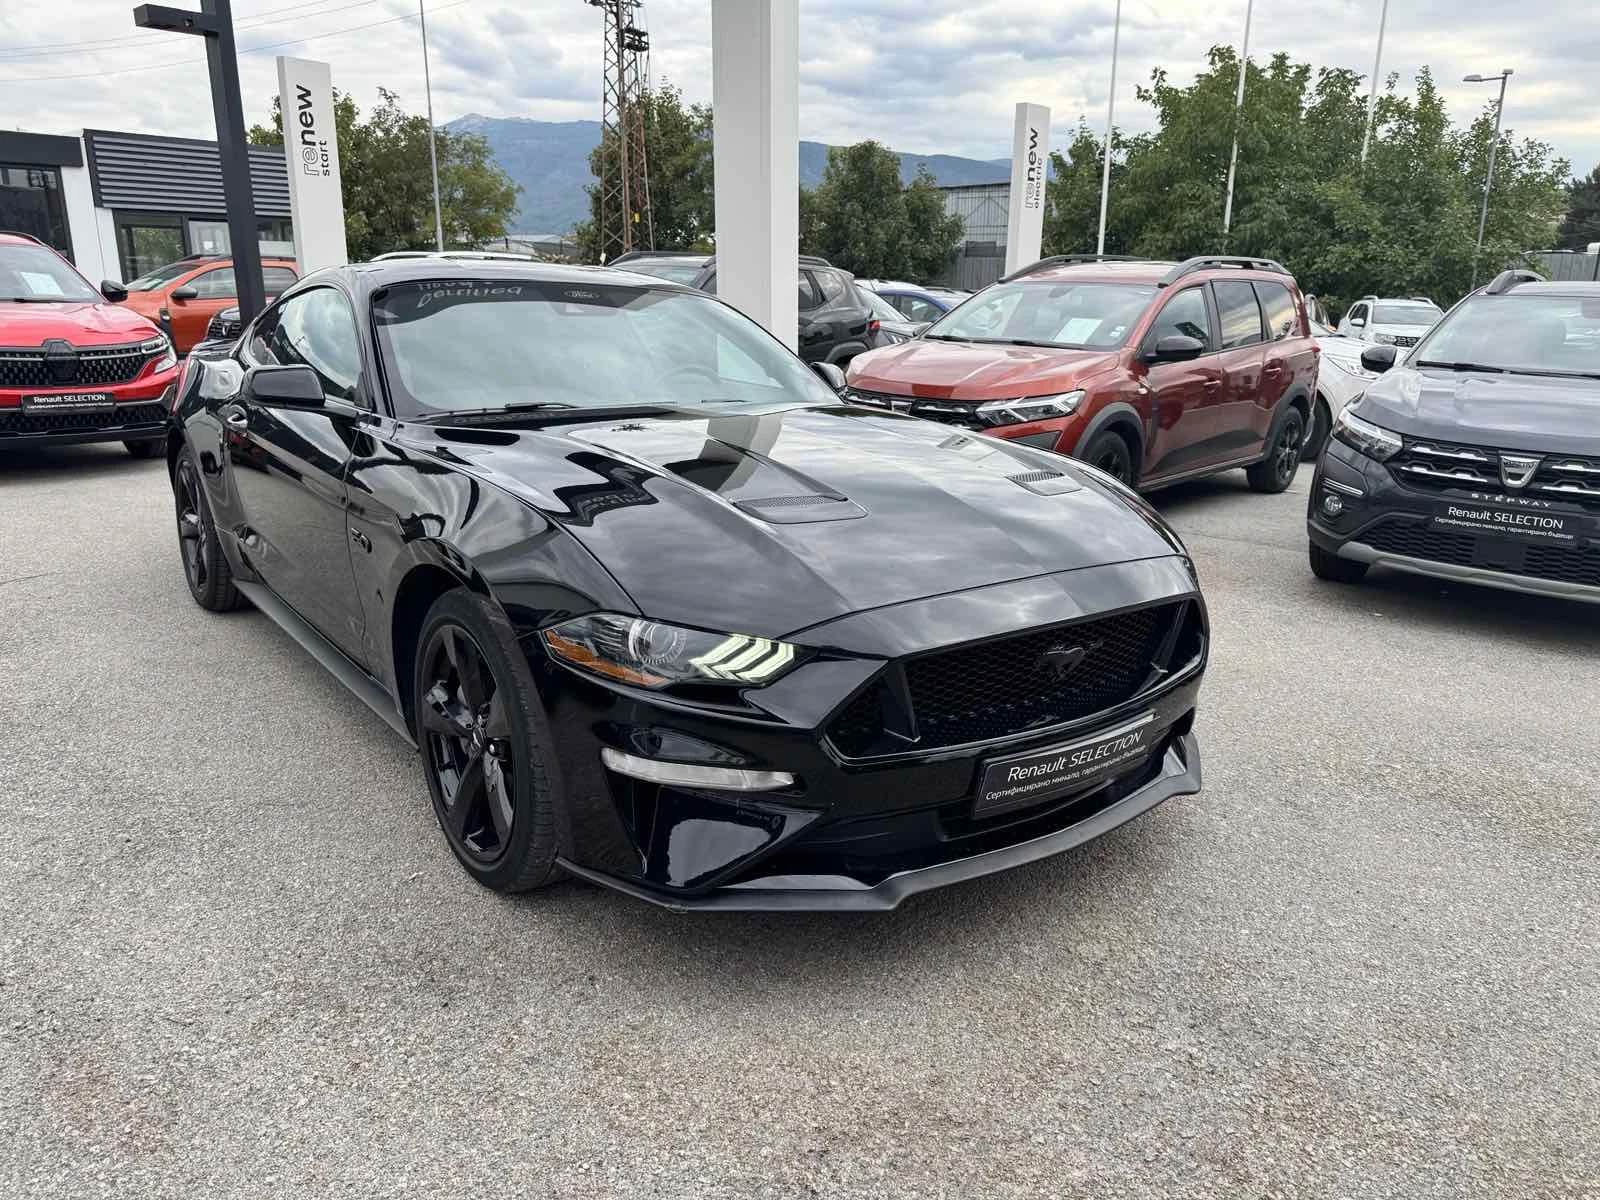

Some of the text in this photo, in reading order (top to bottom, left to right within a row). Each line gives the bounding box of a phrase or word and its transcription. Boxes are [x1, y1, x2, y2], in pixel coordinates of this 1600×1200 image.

[296, 84, 320, 176] renew
[319, 139, 330, 177] start
[1025, 127, 1039, 208] renew
[33, 393, 106, 404] Renault SELECTION
[1471, 493, 1552, 508] STEPWAY
[1448, 506, 1564, 529] Renault SELECTION
[1007, 729, 1144, 782] Renault SELECTION
[986, 779, 1051, 800] Сертифицирано
